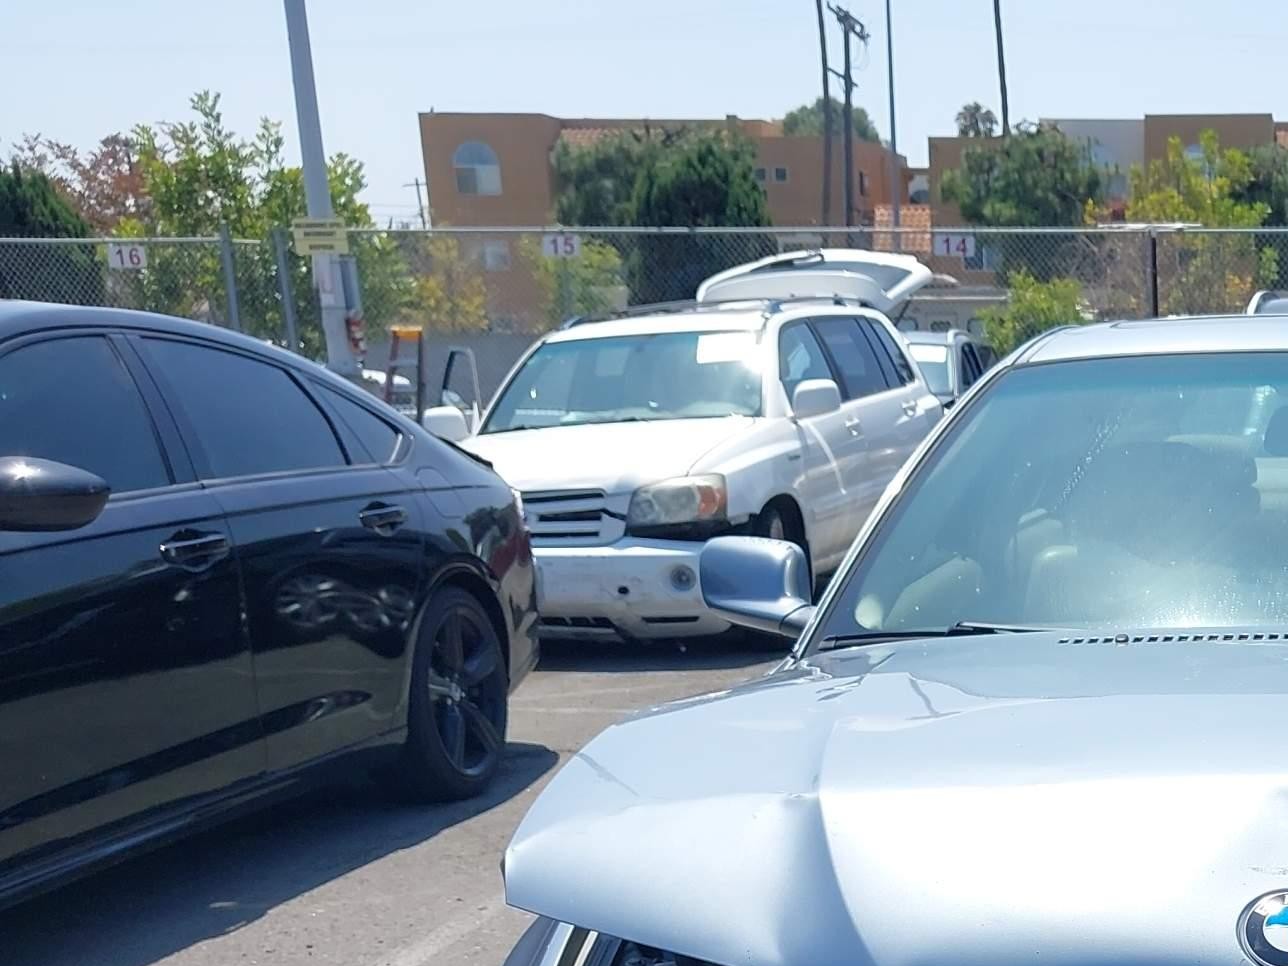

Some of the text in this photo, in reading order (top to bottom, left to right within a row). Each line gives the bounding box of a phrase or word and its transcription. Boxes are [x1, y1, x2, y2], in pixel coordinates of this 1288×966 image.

[549, 236, 575, 255] 15
[941, 237, 967, 255] 14
[116, 246, 142, 266] 16
